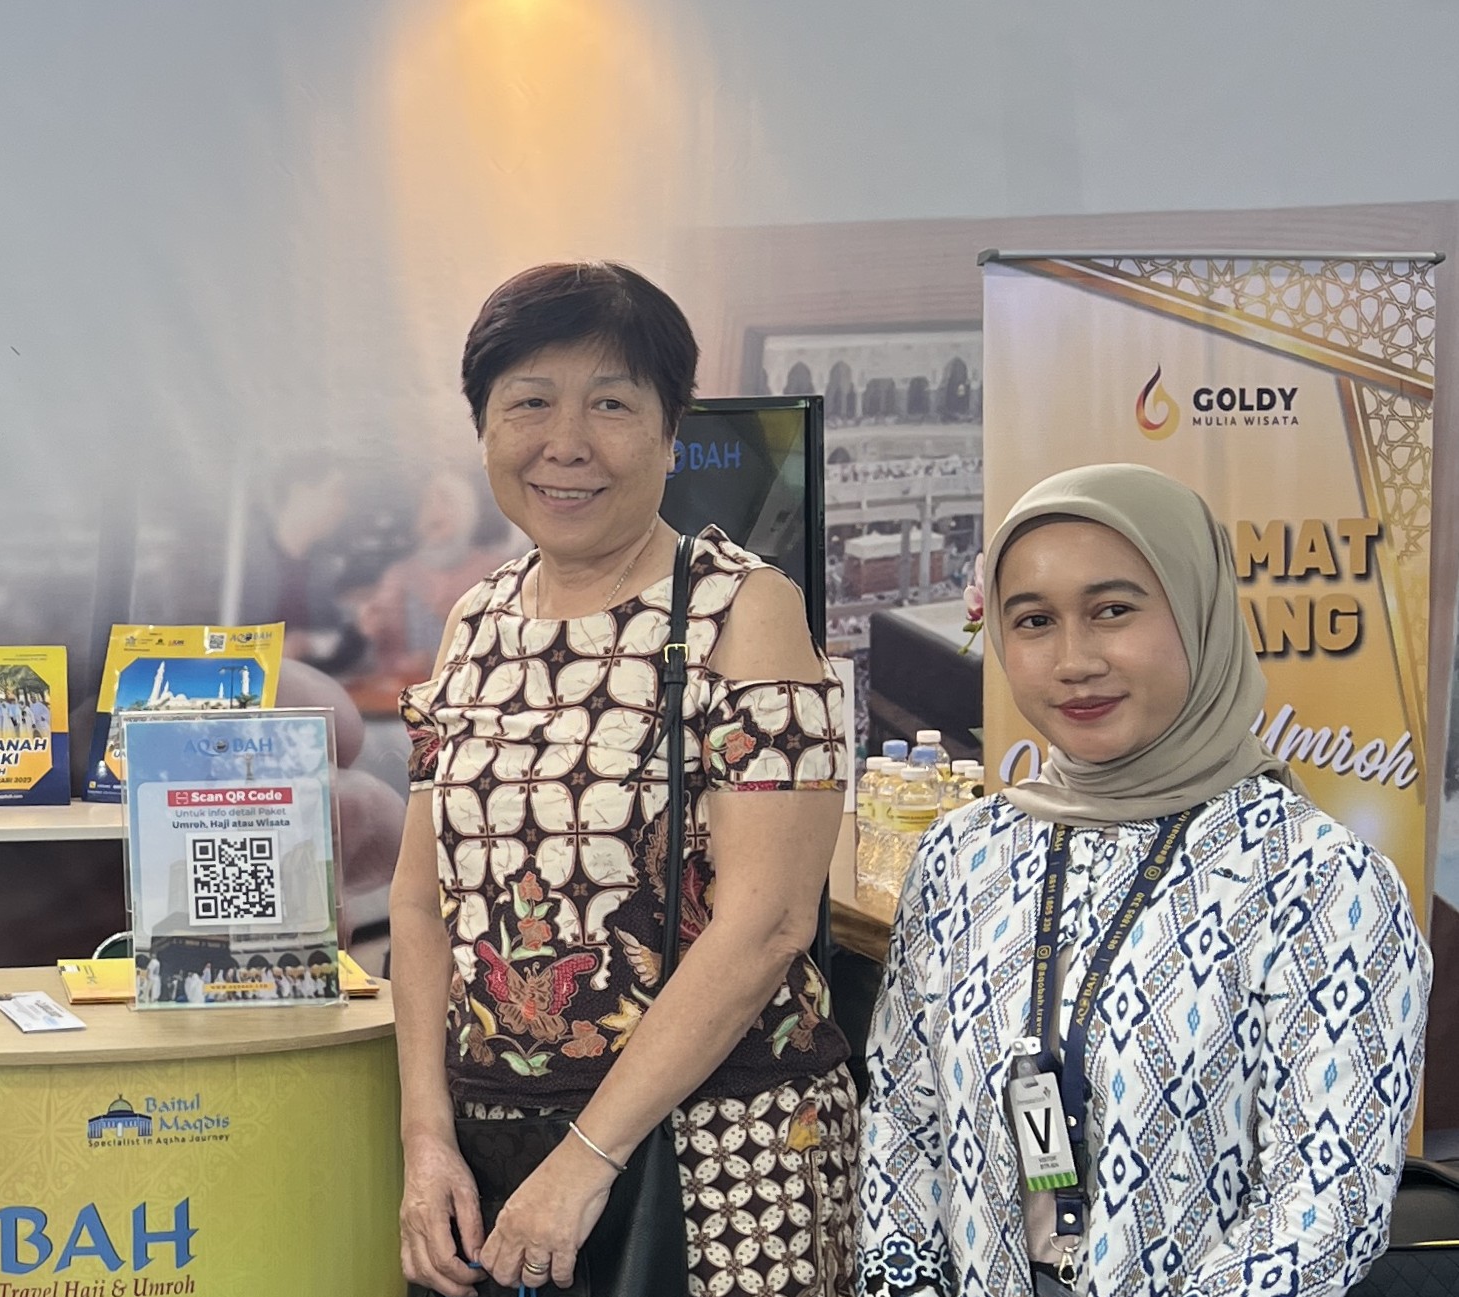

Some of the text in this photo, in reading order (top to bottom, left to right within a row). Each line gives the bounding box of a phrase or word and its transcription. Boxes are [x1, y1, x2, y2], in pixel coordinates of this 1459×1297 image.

[1192, 386, 1299, 412] GOLDY
[1192, 414, 1300, 427] MULIA WISATA
[1236, 518, 1380, 578] MAT
[184, 737, 273, 757] AQOBAH
[190, 789, 283, 804] Scan QR Code
[208, 807, 227, 817] info
[258, 806, 286, 816] Paket
[210, 818, 230, 830] Haji
[231, 819, 255, 828] atau
[255, 818, 291, 828] Wisata
[144, 1093, 201, 1114] Baitul
[158, 1113, 230, 1134] Maqdis
[1023, 1107, 1052, 1154] V
[88, 1138, 141, 1149] Specialist
[132, 1274, 197, 1297] Umroh
